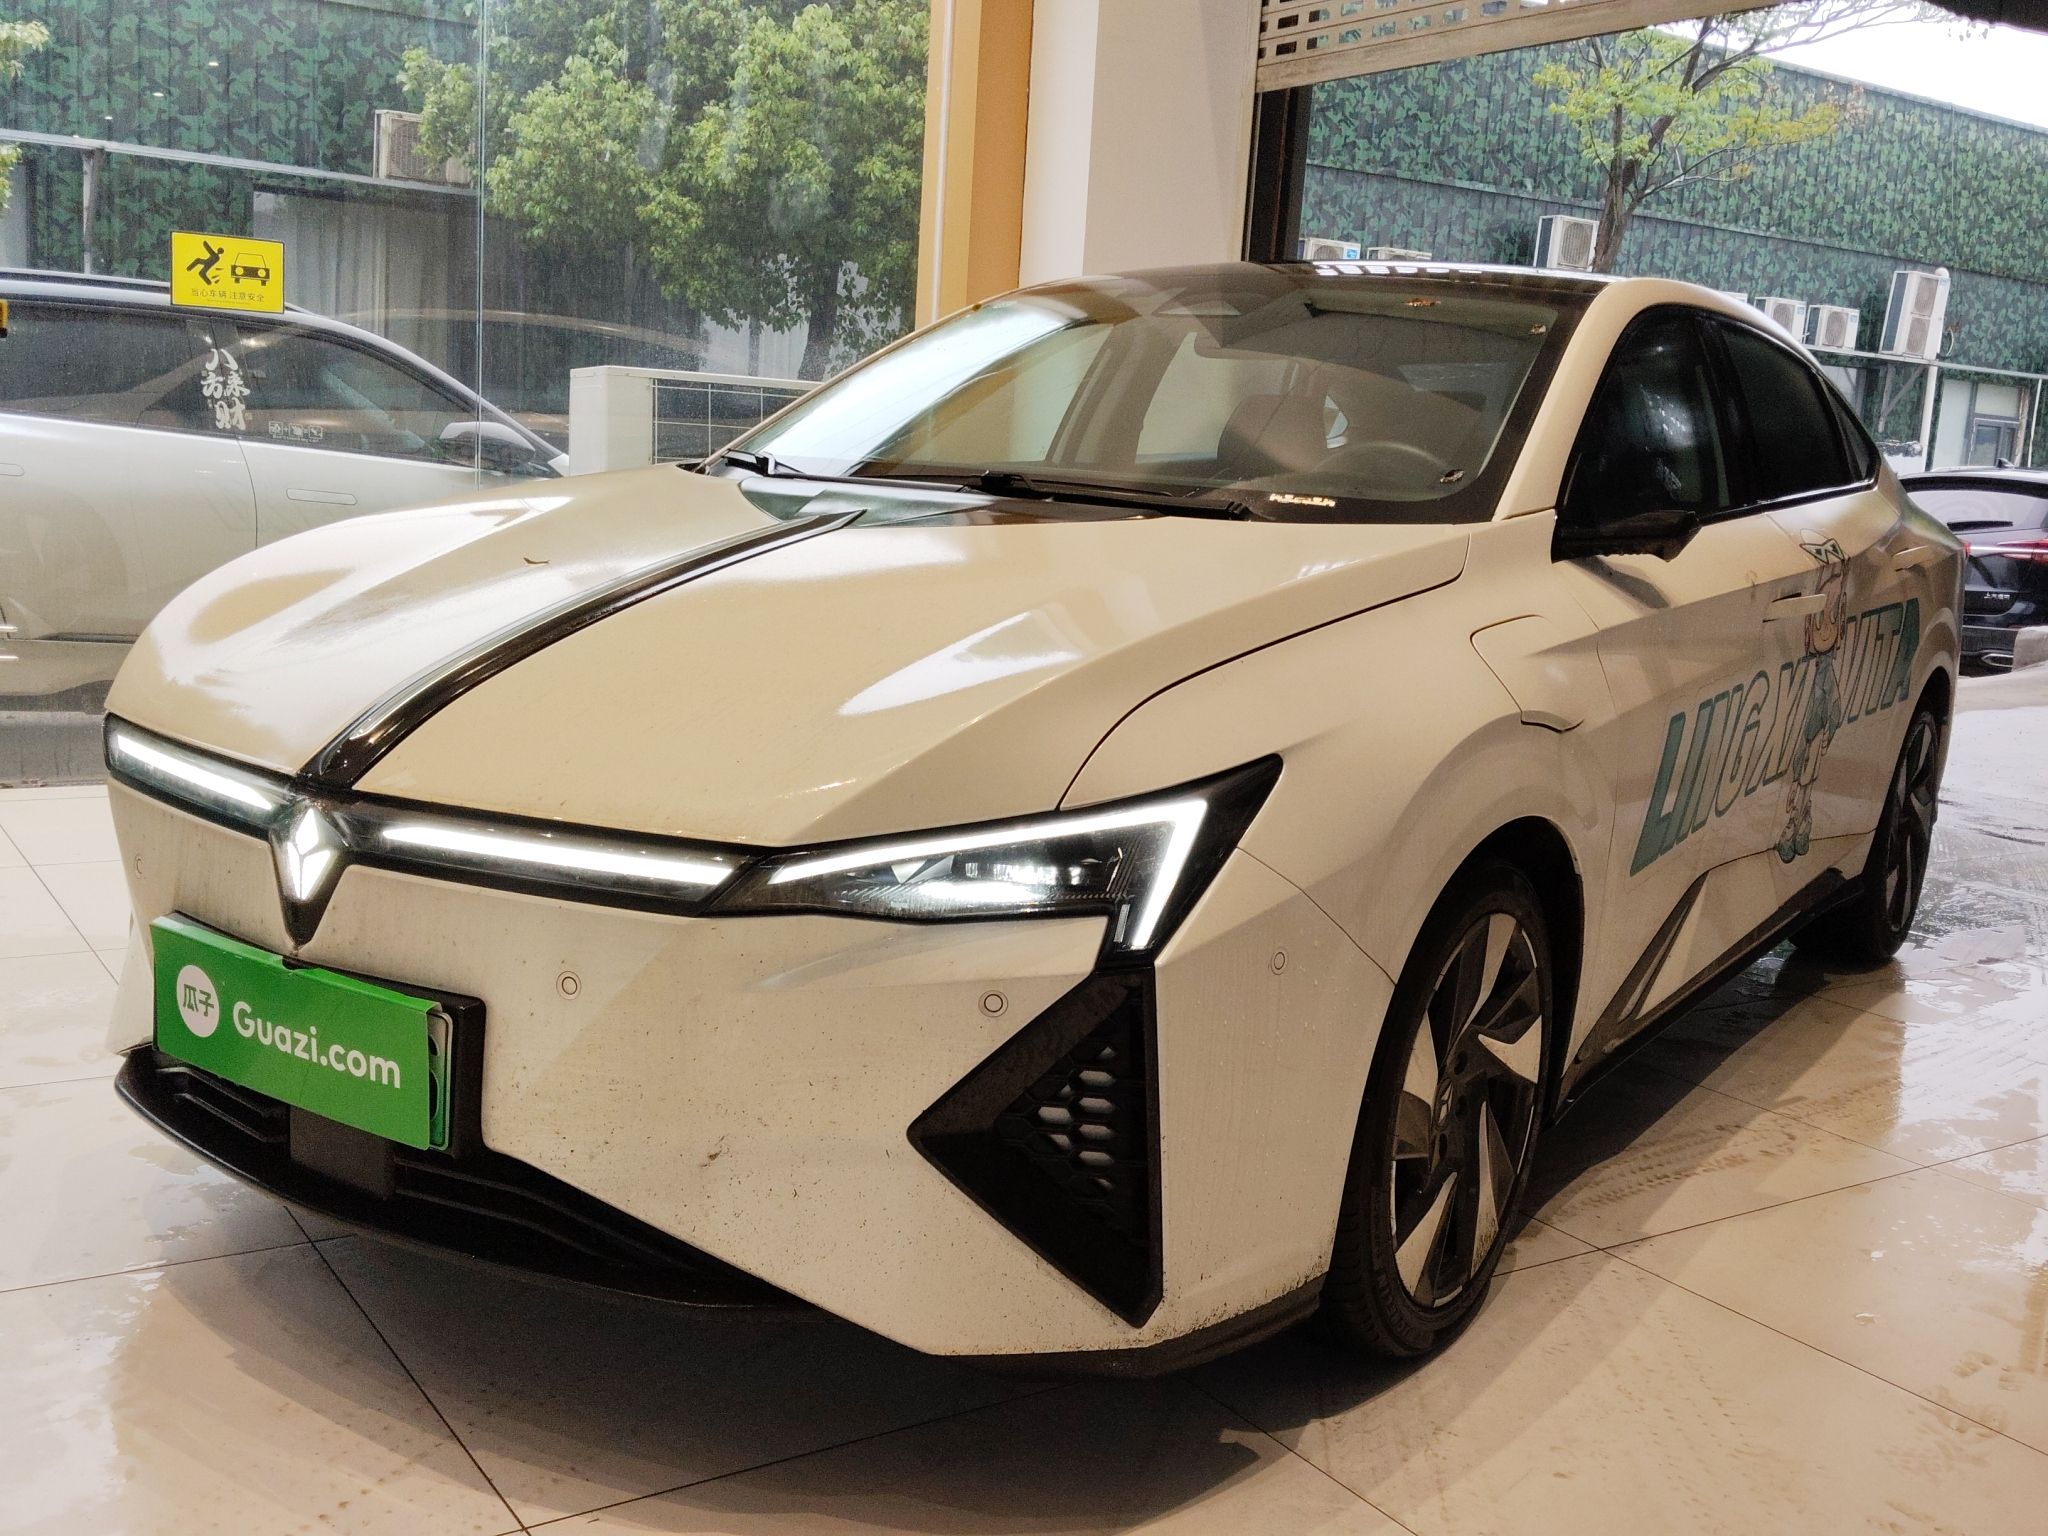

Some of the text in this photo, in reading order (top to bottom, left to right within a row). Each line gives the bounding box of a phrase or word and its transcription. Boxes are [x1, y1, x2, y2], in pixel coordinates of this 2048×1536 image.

[191, 288, 227, 299] 当心车辆
[229, 290, 265, 302] 注意安全
[182, 983, 215, 1018] 瓜子
[233, 1000, 401, 1089] Guazi.com
